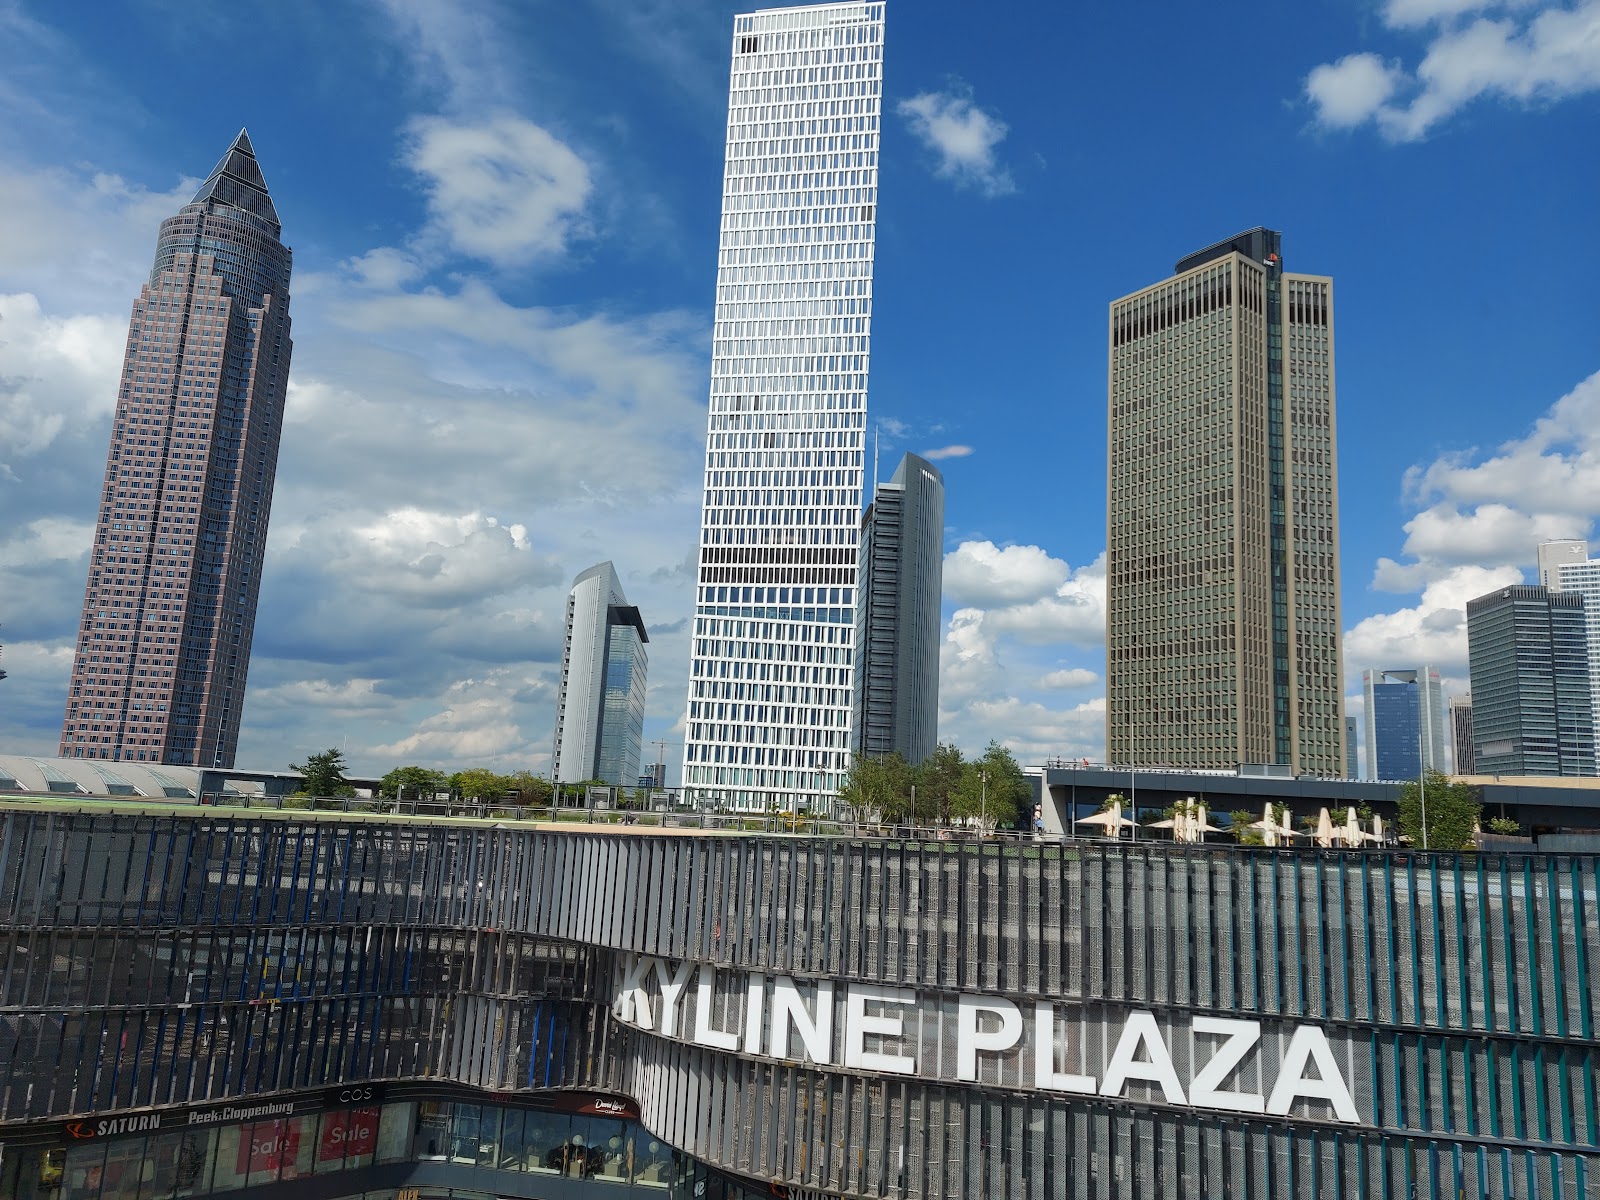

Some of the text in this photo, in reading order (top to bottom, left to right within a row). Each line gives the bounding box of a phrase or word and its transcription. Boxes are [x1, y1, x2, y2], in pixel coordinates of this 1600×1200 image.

[613, 953, 1360, 1123] KYLINE PLAZA
[340, 1087, 372, 1102] COS
[97, 1114, 160, 1136] SATURN
[331, 1124, 370, 1143] Sale
[251, 1136, 290, 1156] Sale
[788, 1186, 839, 1200] SATU
